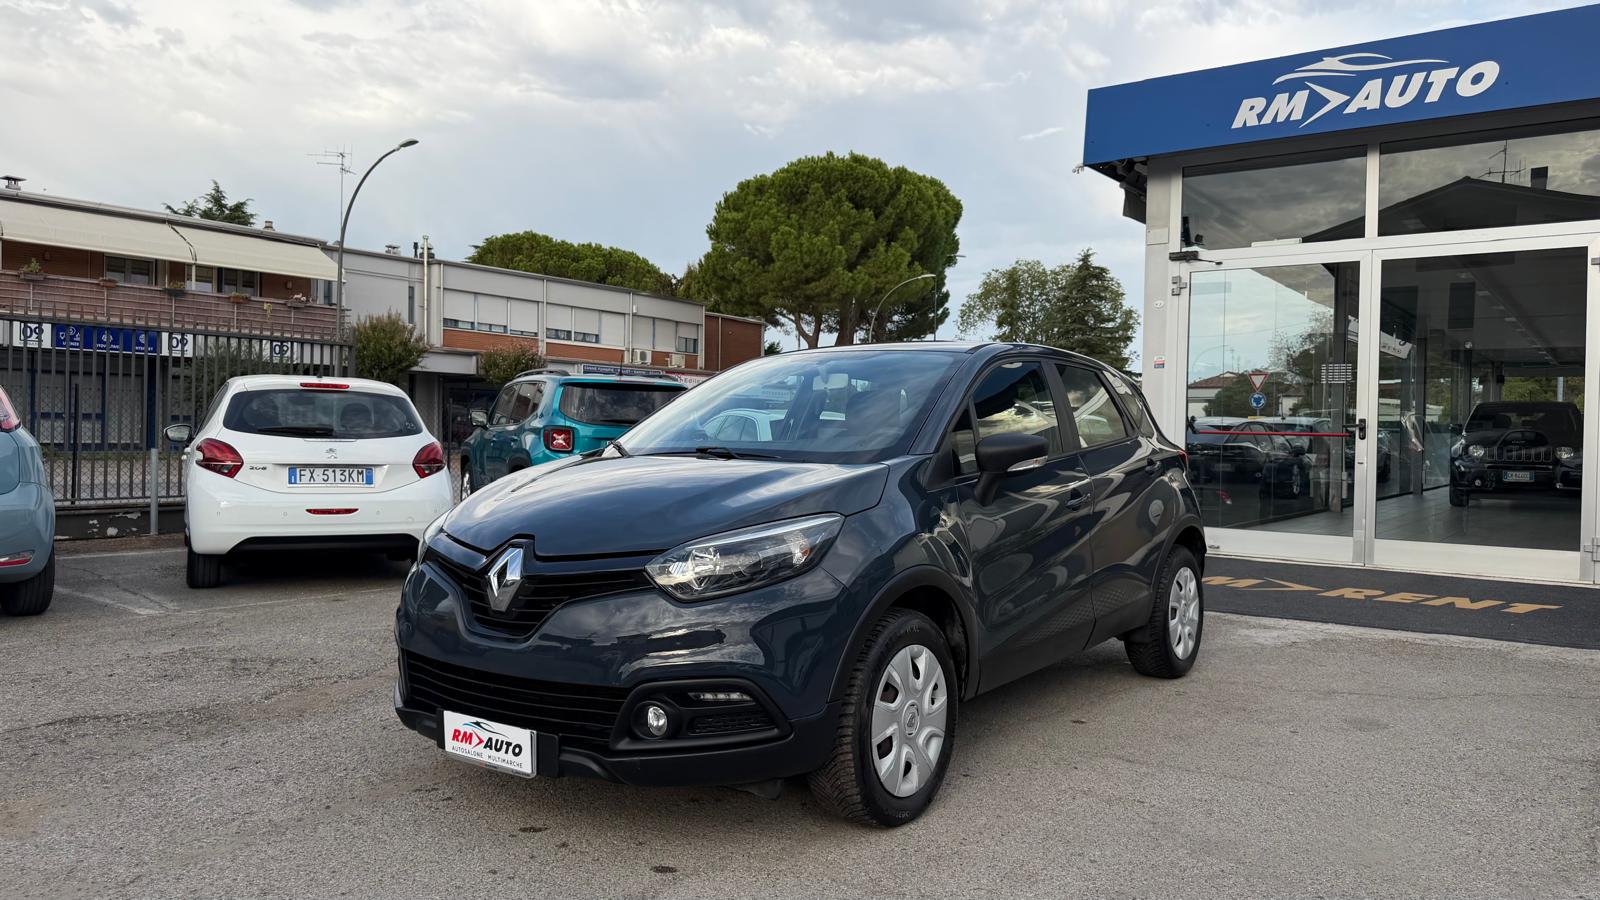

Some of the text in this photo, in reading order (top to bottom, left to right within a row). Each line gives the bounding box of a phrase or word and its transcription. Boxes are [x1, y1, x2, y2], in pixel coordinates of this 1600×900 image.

[1231, 60, 1500, 129] RM AUTO
[1317, 587, 1564, 613] RENT
[452, 728, 523, 758] RM AUTO
[452, 745, 483, 758] AUTOSALONE
[488, 755, 523, 768] MULTIMARCHE
